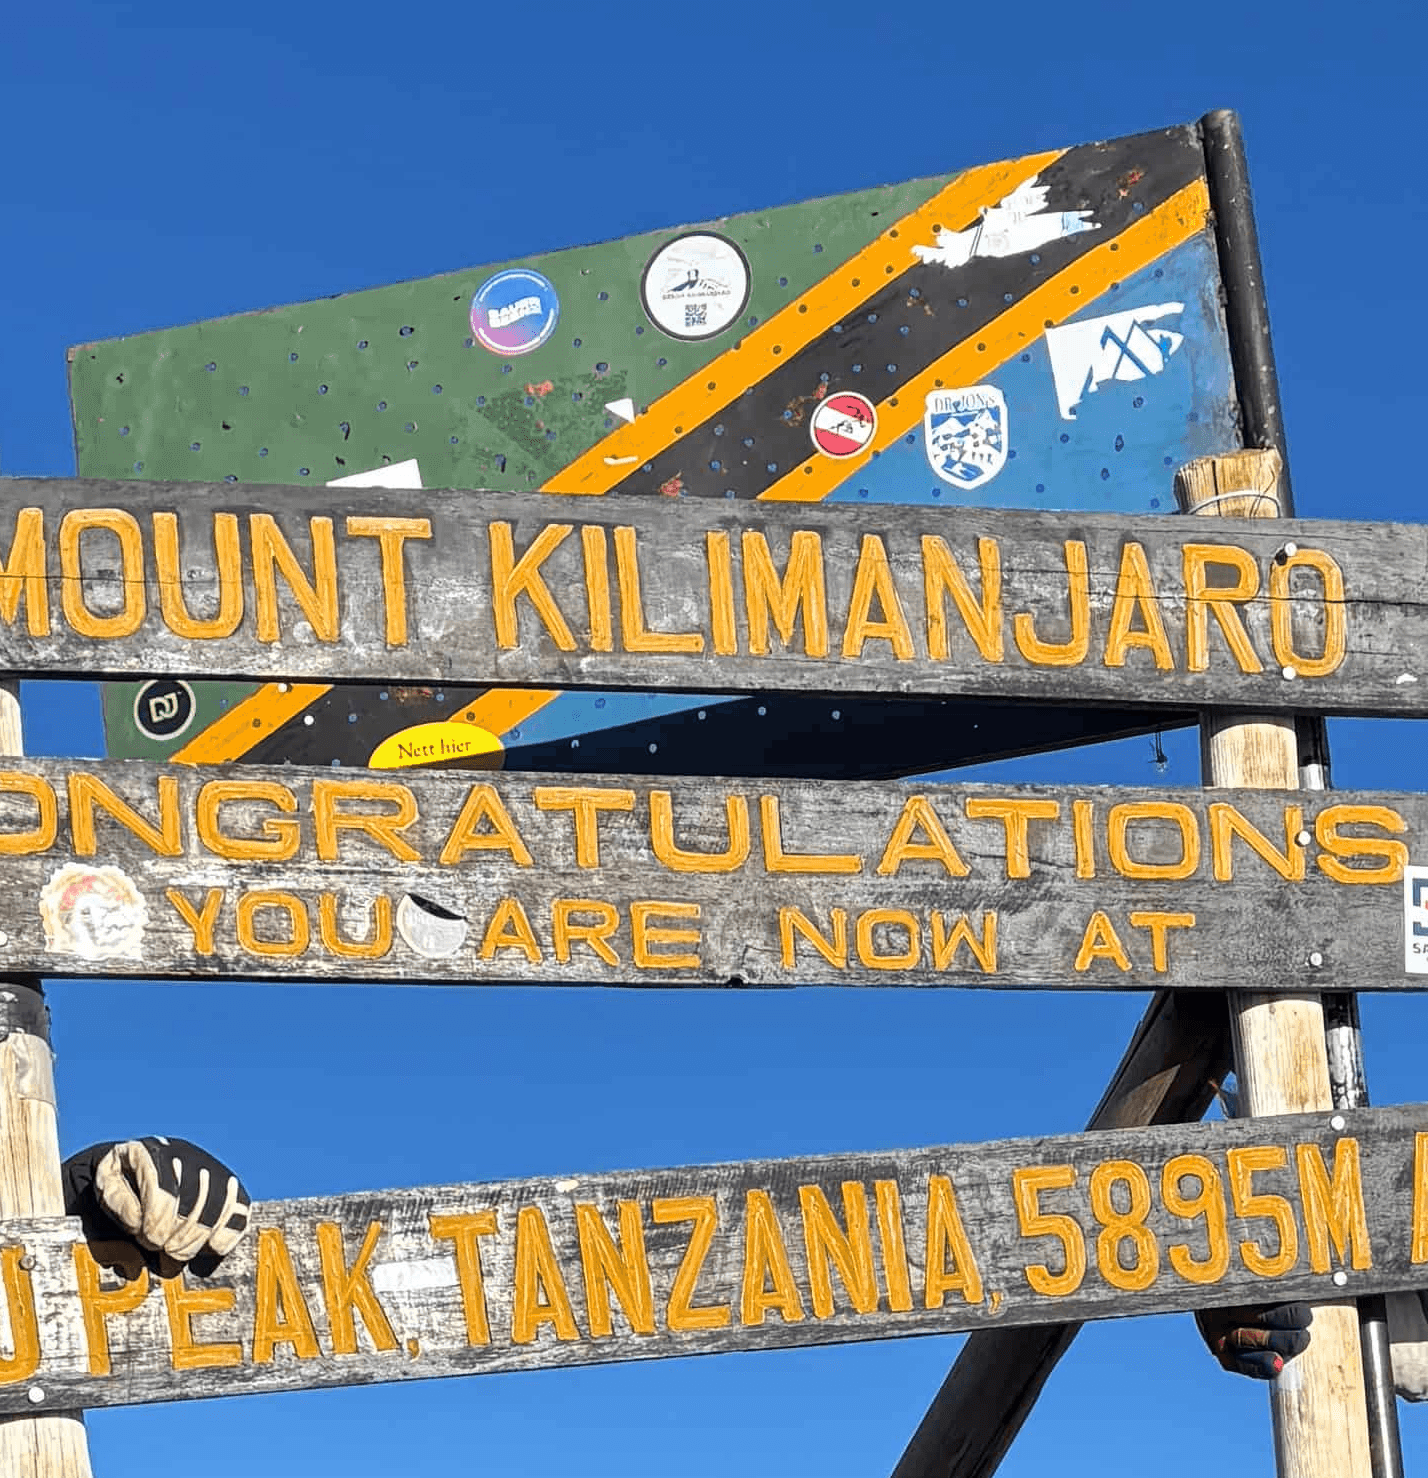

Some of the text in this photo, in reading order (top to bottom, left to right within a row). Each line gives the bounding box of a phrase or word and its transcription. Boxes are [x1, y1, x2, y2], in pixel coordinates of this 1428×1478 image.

[490, 524, 1347, 678] KILIMANJARO
[397, 739, 472, 760] Nett hier
[168, 887, 1195, 974] YOU ARE NOW AT
[72, 1221, 423, 1378] PEAK,
[429, 1172, 1003, 1348] TANZANIA,
[1012, 1136, 1372, 1298] 5895M
